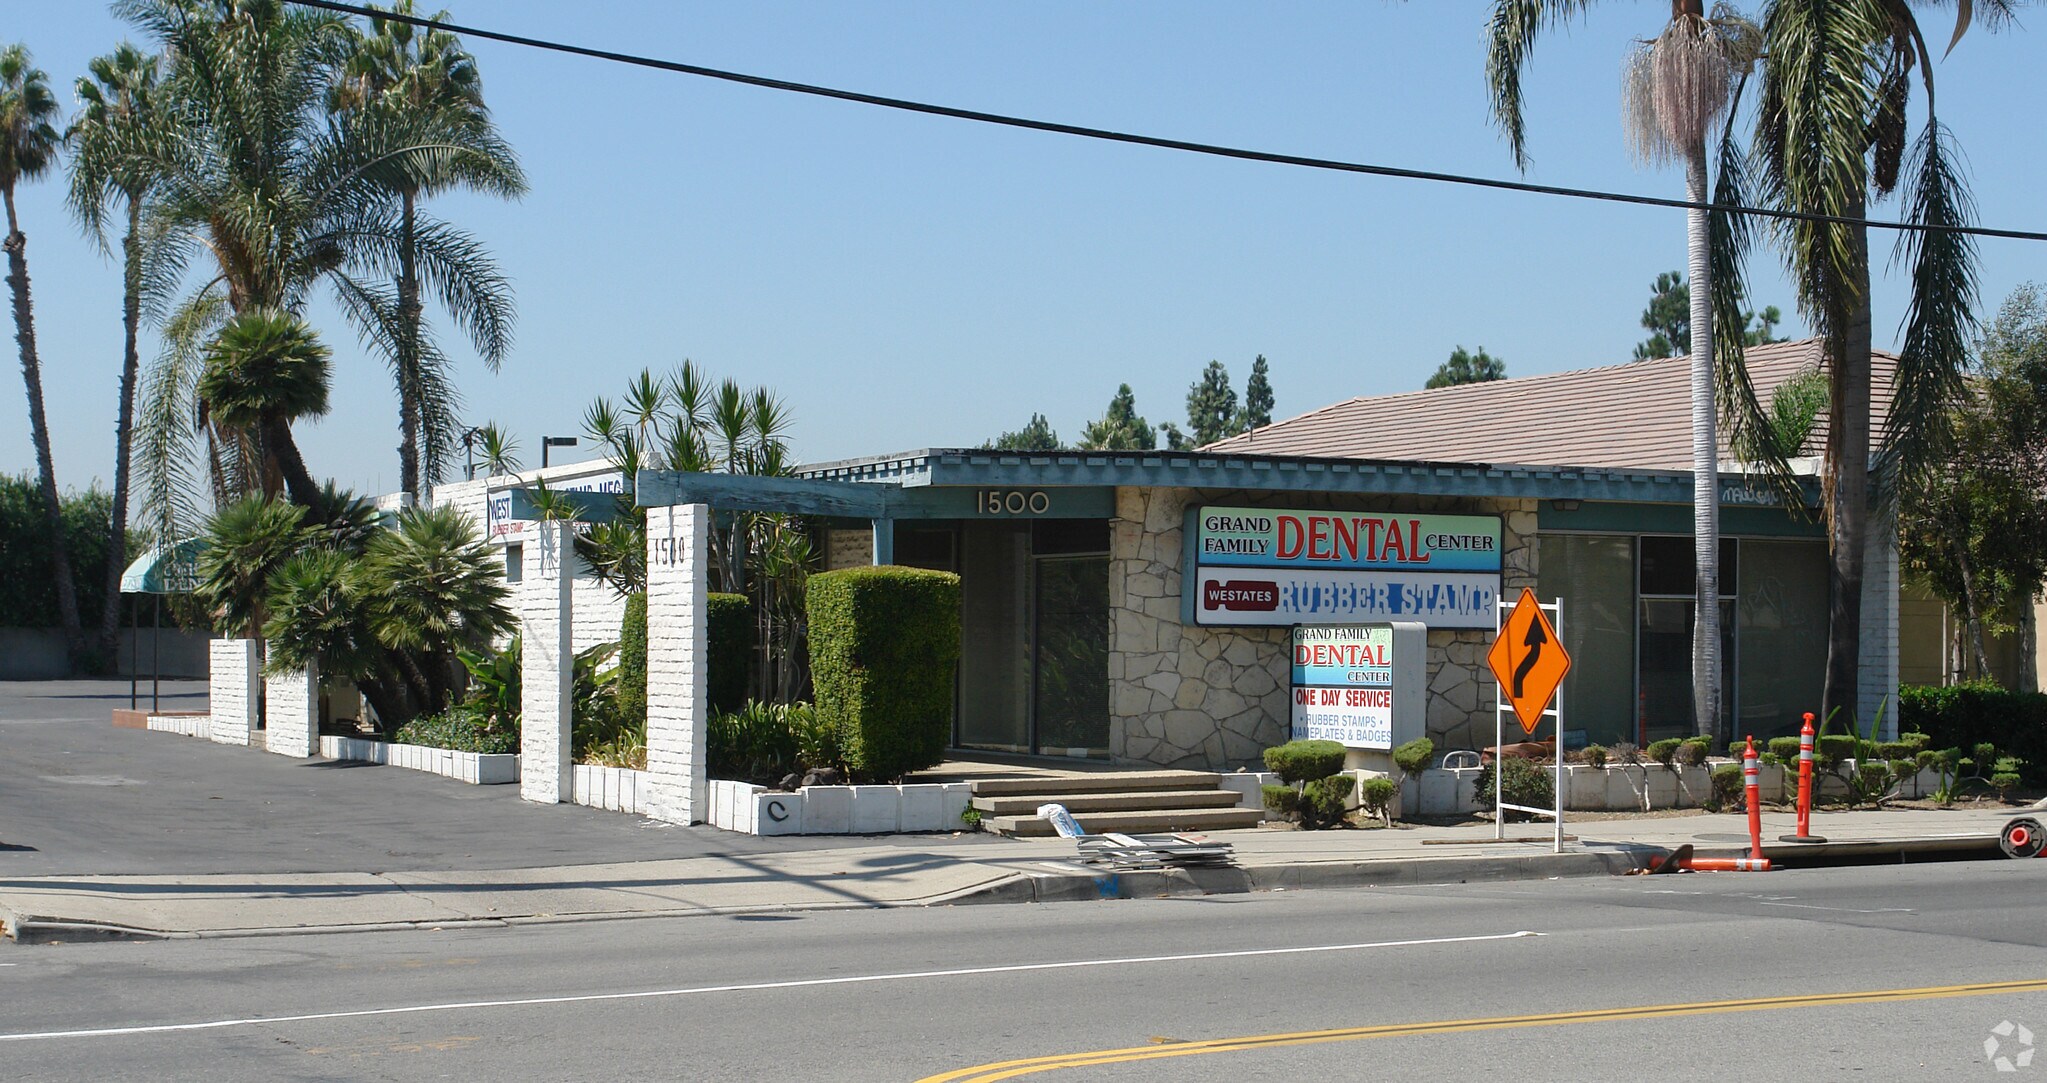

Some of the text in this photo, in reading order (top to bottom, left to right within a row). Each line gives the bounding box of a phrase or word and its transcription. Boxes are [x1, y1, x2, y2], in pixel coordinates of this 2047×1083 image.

[978, 491, 1050, 514] 1500
[1205, 516, 1272, 533] GRAND
[1204, 538, 1270, 555] FAMILY
[1275, 515, 1431, 563] DENTAL
[1425, 534, 1494, 551] CENTER
[655, 536, 684, 566] 1500
[1209, 590, 1272, 602] WESTATES
[1281, 581, 1495, 615] RUBBER STAMP
[1295, 628, 1372, 641] GRAND FAMILY
[1295, 645, 1391, 667] DENTAL
[1347, 671, 1390, 683] CENTER
[1296, 688, 1391, 708] ONE DAY SERVICE
[1306, 713, 1376, 728] RUBBER STAMPS
[1292, 726, 1392, 743] NAMEPLATES & BADGES
